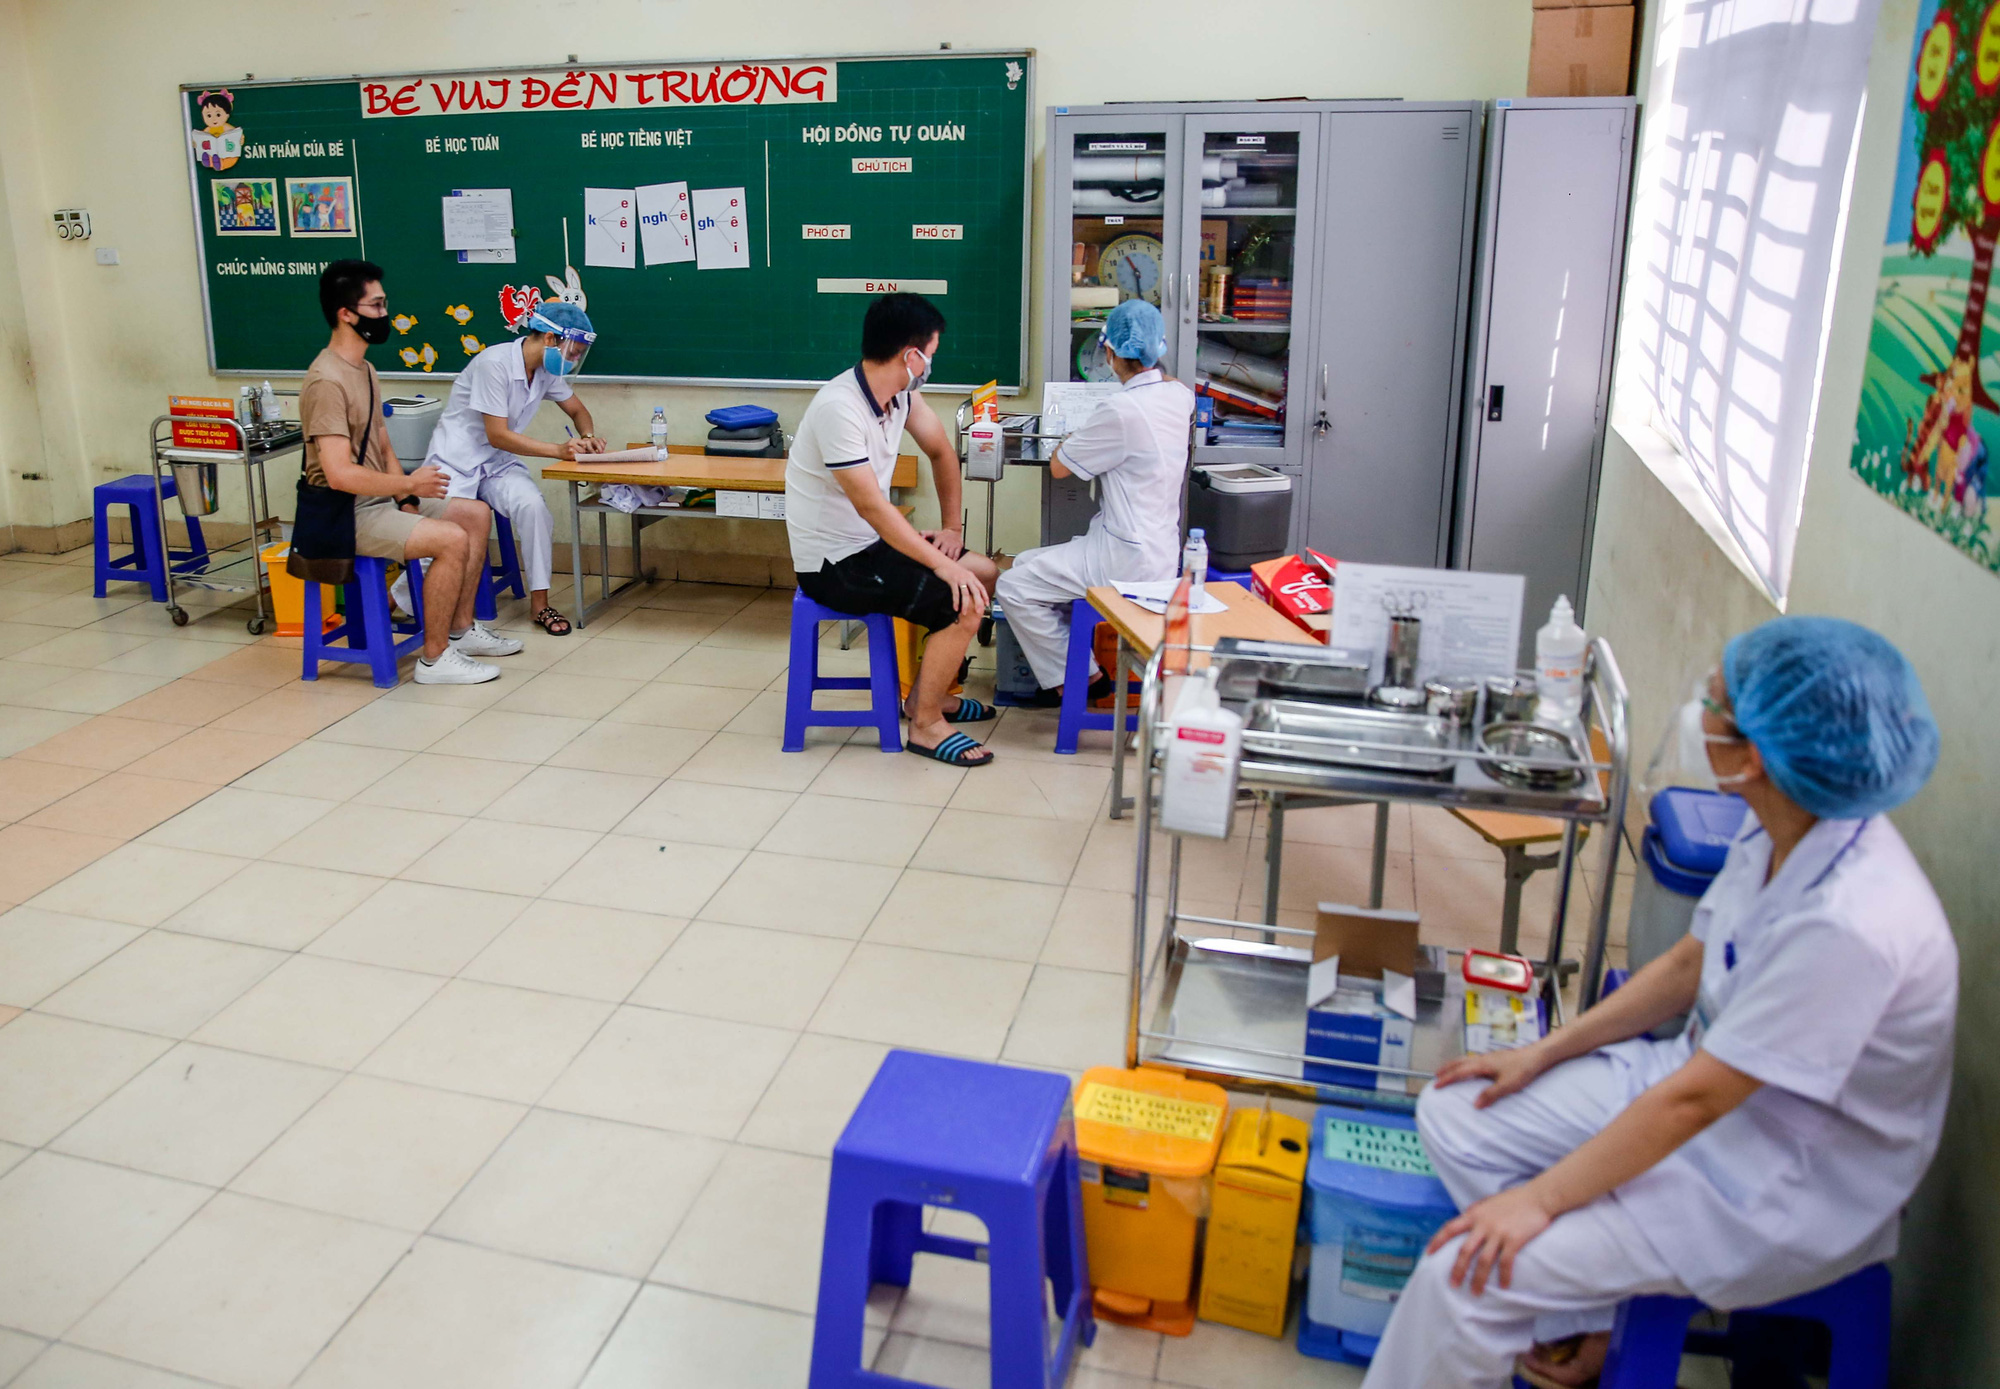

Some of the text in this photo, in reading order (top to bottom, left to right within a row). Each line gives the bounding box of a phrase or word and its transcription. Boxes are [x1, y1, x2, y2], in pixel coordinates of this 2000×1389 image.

[363, 79, 423, 116] BÉ
[521, 71, 617, 110] ĐẾN
[625, 65, 828, 105] TRƯỜNG
[581, 130, 597, 148] BÉ
[600, 132, 625, 150] HỌC
[665, 128, 693, 149] VIỆT
[802, 120, 966, 146] HỘI ĐỒNG TỰ QUẢN
[244, 139, 344, 159] SẢN PHẨM CỦA BÉ
[425, 133, 500, 155] BÉ HỌC TOÁN
[857, 159, 907, 173] CHỦ TỊCH
[679, 192, 687, 200] e
[730, 198, 738, 207] e
[621, 200, 628, 208] e
[588, 214, 597, 225] k
[642, 211, 668, 226] ngh
[680, 209, 688, 221] ê
[730, 216, 738, 227] ê
[620, 217, 627, 228] ê
[698, 217, 715, 230] gh
[807, 226, 845, 238] PHÓ CT
[915, 225, 956, 238] PHÓ CT
[216, 257, 248, 275] CHÚC
[250, 256, 285, 275] MỪNG
[288, 262, 317, 275] SINH
[866, 283, 898, 292] BAN
